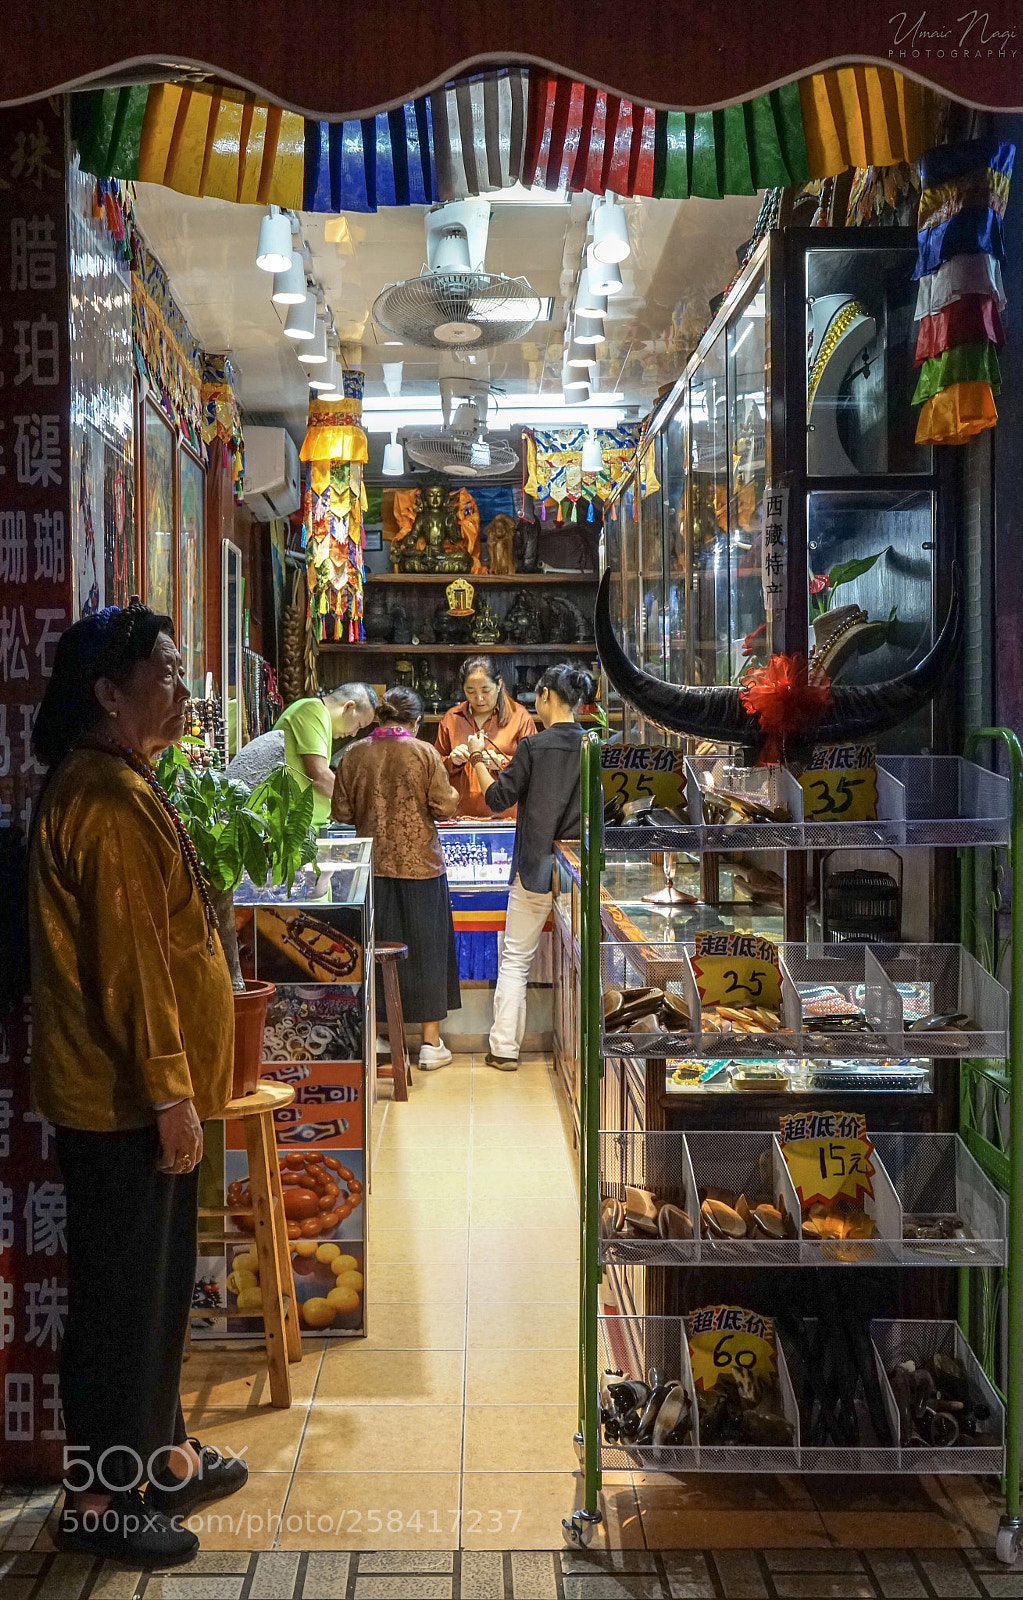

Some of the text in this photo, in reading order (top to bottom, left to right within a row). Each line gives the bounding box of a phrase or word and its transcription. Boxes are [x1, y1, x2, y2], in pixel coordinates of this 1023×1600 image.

[0, 118, 62, 191] 珠
[0, 312, 59, 387] 珀
[0, 412, 62, 488] 磲
[601, 746, 679, 773] 超低价
[610, 771, 654, 809] 35
[809, 775, 866, 815] 35
[699, 934, 776, 965] 超低价
[722, 969, 767, 997] 25
[783, 1114, 862, 1142] 超低价
[692, 1308, 768, 1338] 超低价
[712, 1334, 757, 1369] 60
